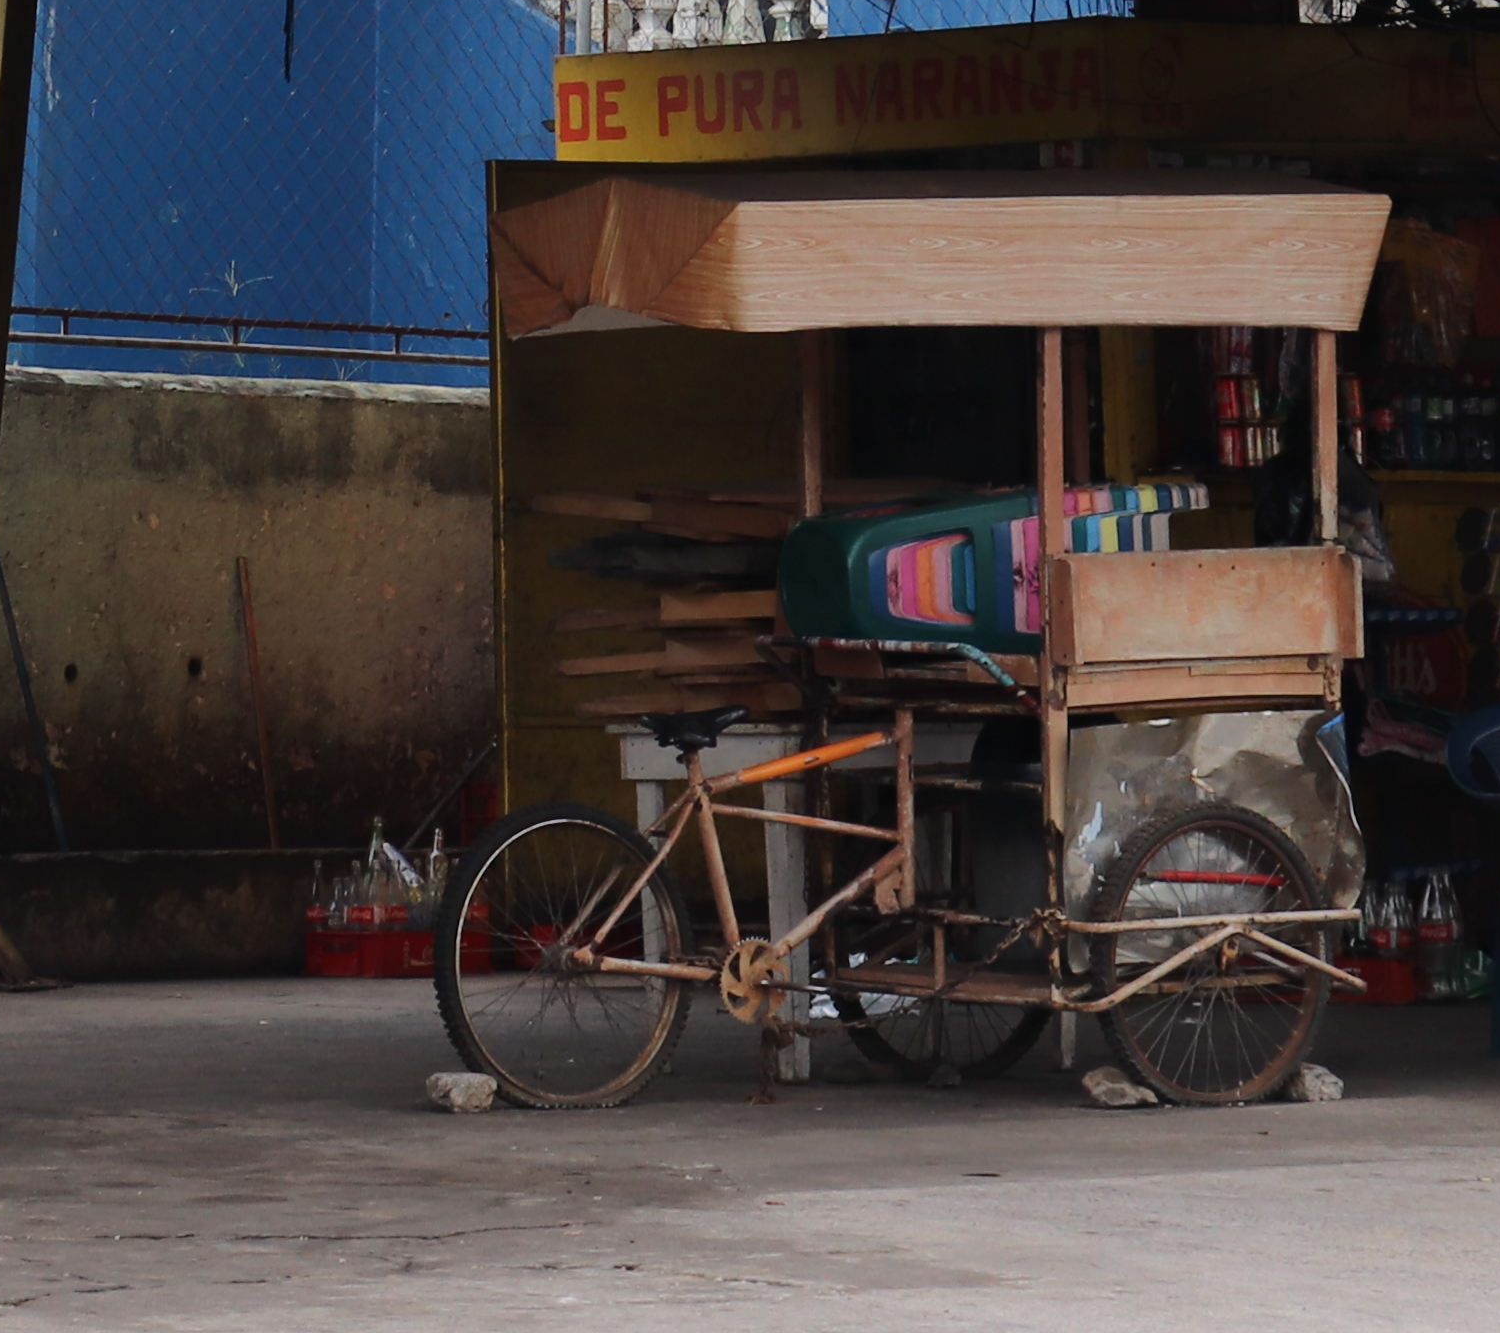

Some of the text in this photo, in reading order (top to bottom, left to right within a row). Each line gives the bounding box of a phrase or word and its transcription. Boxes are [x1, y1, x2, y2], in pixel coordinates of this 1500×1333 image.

[558, 45, 1100, 143] DE PURA NARANJA
